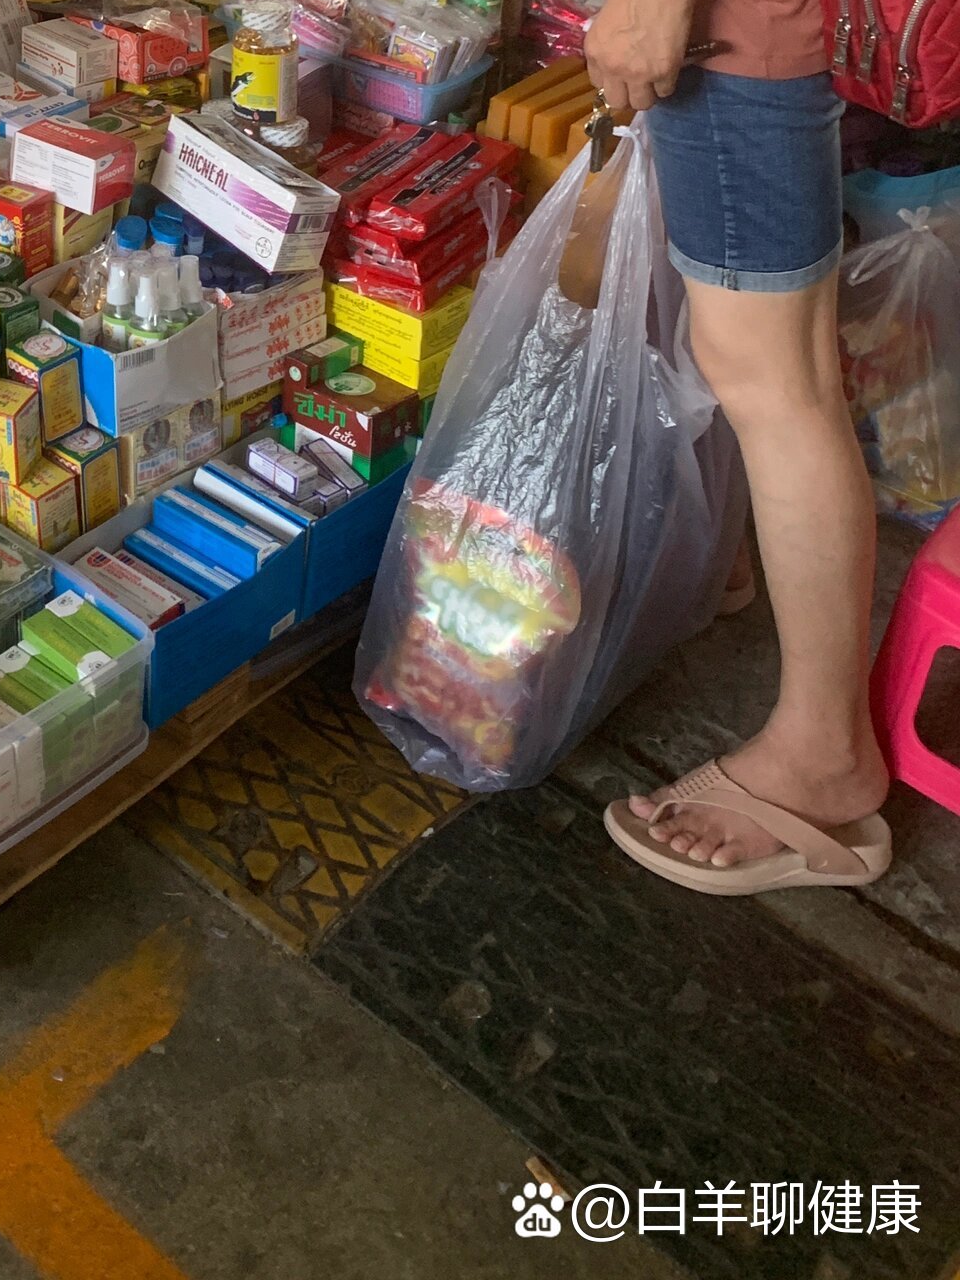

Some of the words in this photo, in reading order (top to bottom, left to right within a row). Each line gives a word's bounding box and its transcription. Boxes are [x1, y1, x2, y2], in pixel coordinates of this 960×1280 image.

[41, 122, 98, 145] FERROVIT
[98, 165, 126, 182] FERROVIT
[178, 143, 230, 192] HAICNEAL
